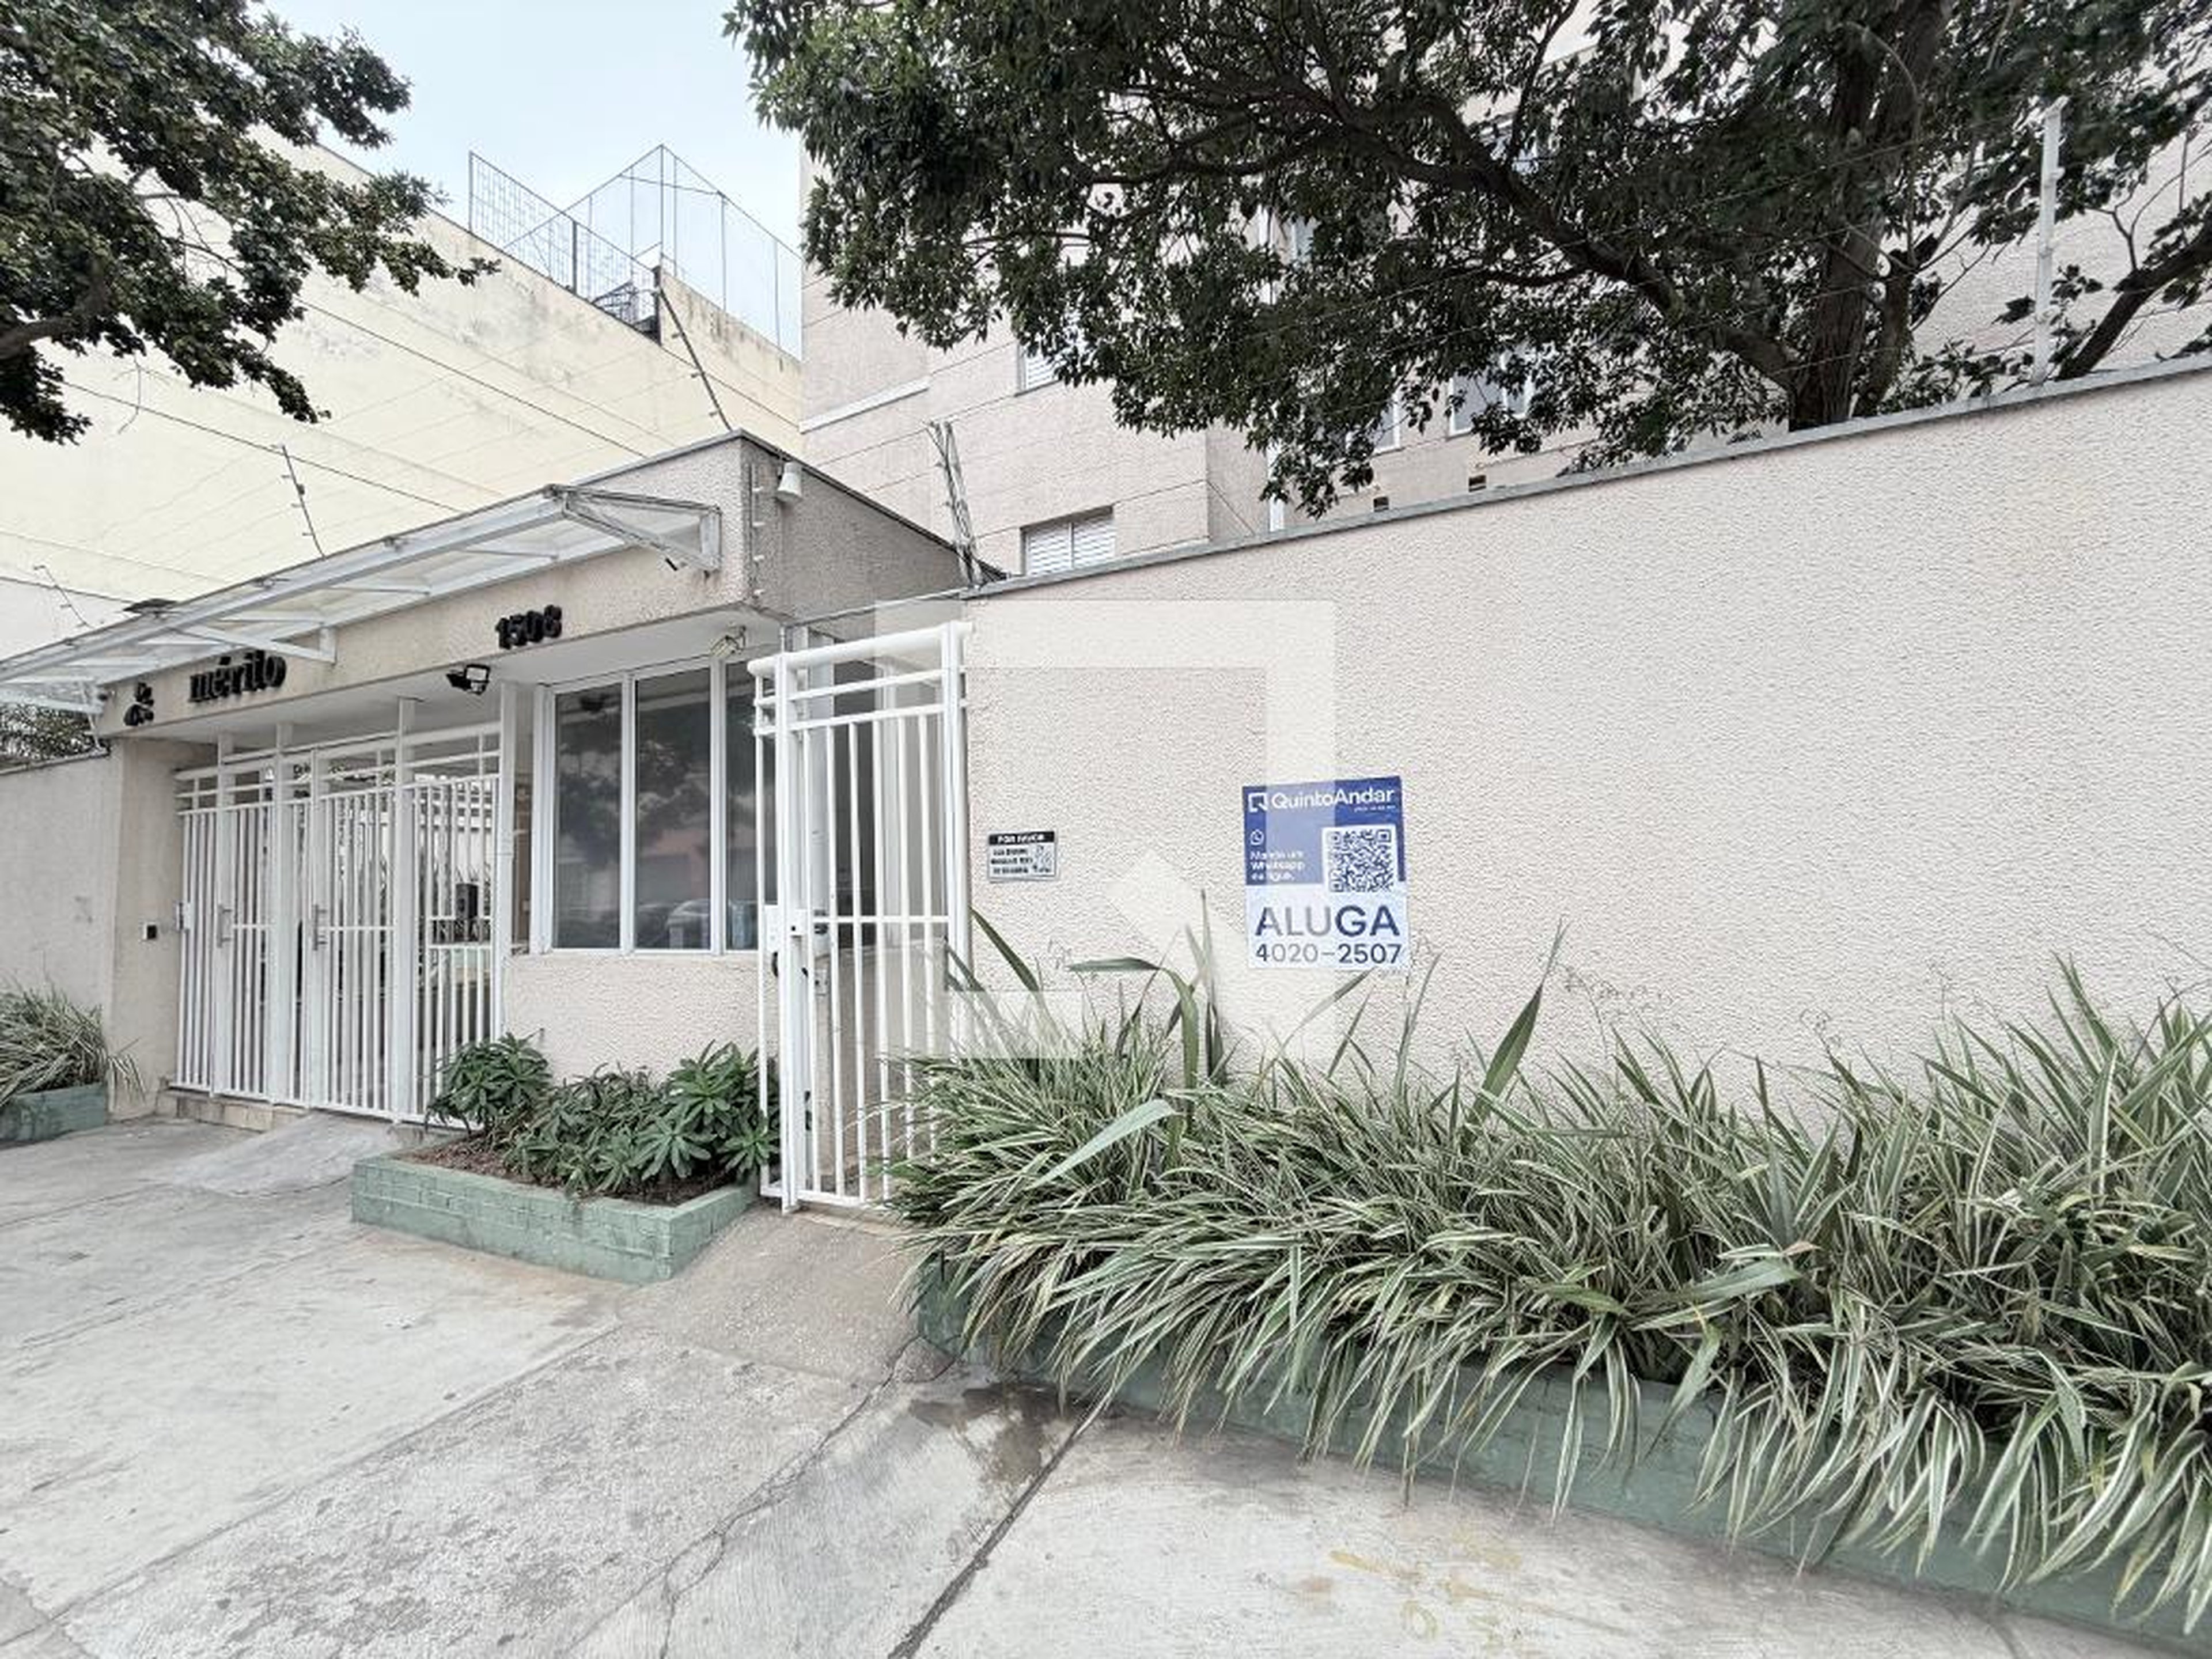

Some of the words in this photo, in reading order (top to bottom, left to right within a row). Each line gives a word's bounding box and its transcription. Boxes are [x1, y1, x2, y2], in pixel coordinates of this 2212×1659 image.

[1271, 787, 1395, 809] QuintoAndar
[1255, 905, 1400, 937] ALUGA
[1256, 943, 1402, 964] 4020-2507
